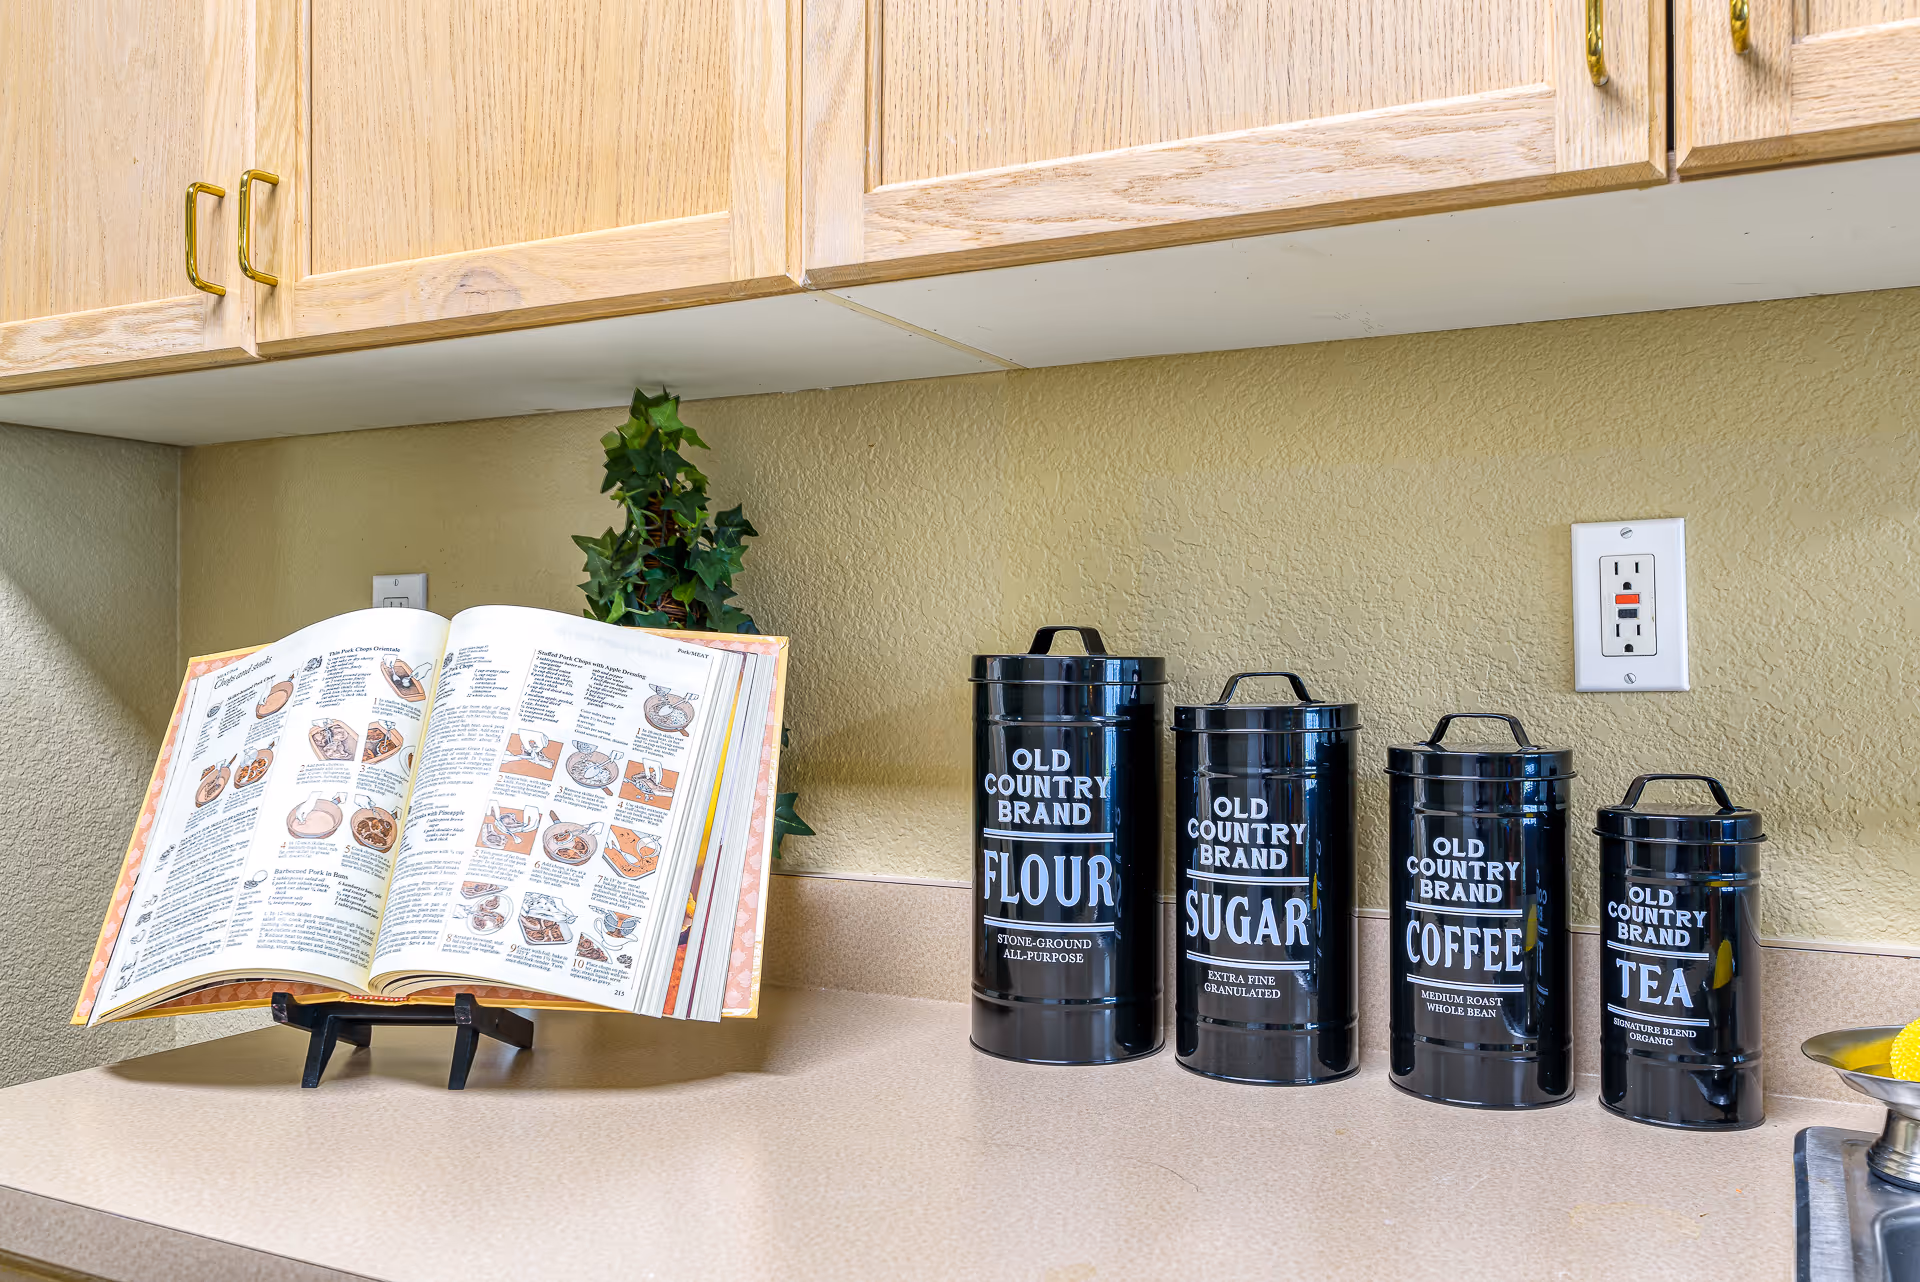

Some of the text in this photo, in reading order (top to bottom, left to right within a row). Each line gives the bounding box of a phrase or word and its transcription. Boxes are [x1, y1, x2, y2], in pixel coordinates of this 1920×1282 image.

[678, 648, 709, 658] Pork/MEAT
[622, 669, 646, 680] Dressing
[1012, 748, 1071, 772] OLD
[557, 786, 563, 794] 3
[984, 773, 1111, 799] COUNTRY
[998, 800, 1092, 825] BRAND
[1214, 796, 1268, 820] OLD
[1187, 818, 1308, 845] COUNTRY
[345, 845, 350, 853] 5
[472, 849, 479, 857] 5
[1433, 837, 1485, 858] OLD
[1200, 843, 1288, 870] BRAND
[308, 868, 324, 876] Pork
[333, 872, 348, 880] Buns
[1406, 855, 1520, 881] COUNTRY
[598, 875, 603, 883] 7
[984, 850, 1114, 907] FLOUR
[1419, 879, 1503, 903] BRAND
[1629, 886, 1674, 907] OLD
[1186, 889, 1309, 946] SUGAR
[1608, 901, 1707, 928] COUNTRY
[446, 934, 452, 942] 8
[997, 934, 1092, 949] STONE-GROUND
[1618, 921, 1691, 947] BRAND
[510, 944, 517, 952] 9
[1406, 919, 1523, 972] COFFEE
[573, 959, 584, 968] 10
[1003, 949, 1084, 963] ALL-PURPOSE
[1208, 970, 1276, 985] EXTRA FINE
[1615, 958, 1694, 1008] TEA
[614, 989, 625, 997] 215
[1204, 982, 1281, 999] GRANULATED
[1421, 989, 1503, 1006] MEDIUM ROAST
[1427, 1002, 1496, 1018] WHOLE BEAN
[1613, 1017, 1697, 1038] SIGNATURE BLEND
[1629, 1032, 1674, 1046] ORGANIC
